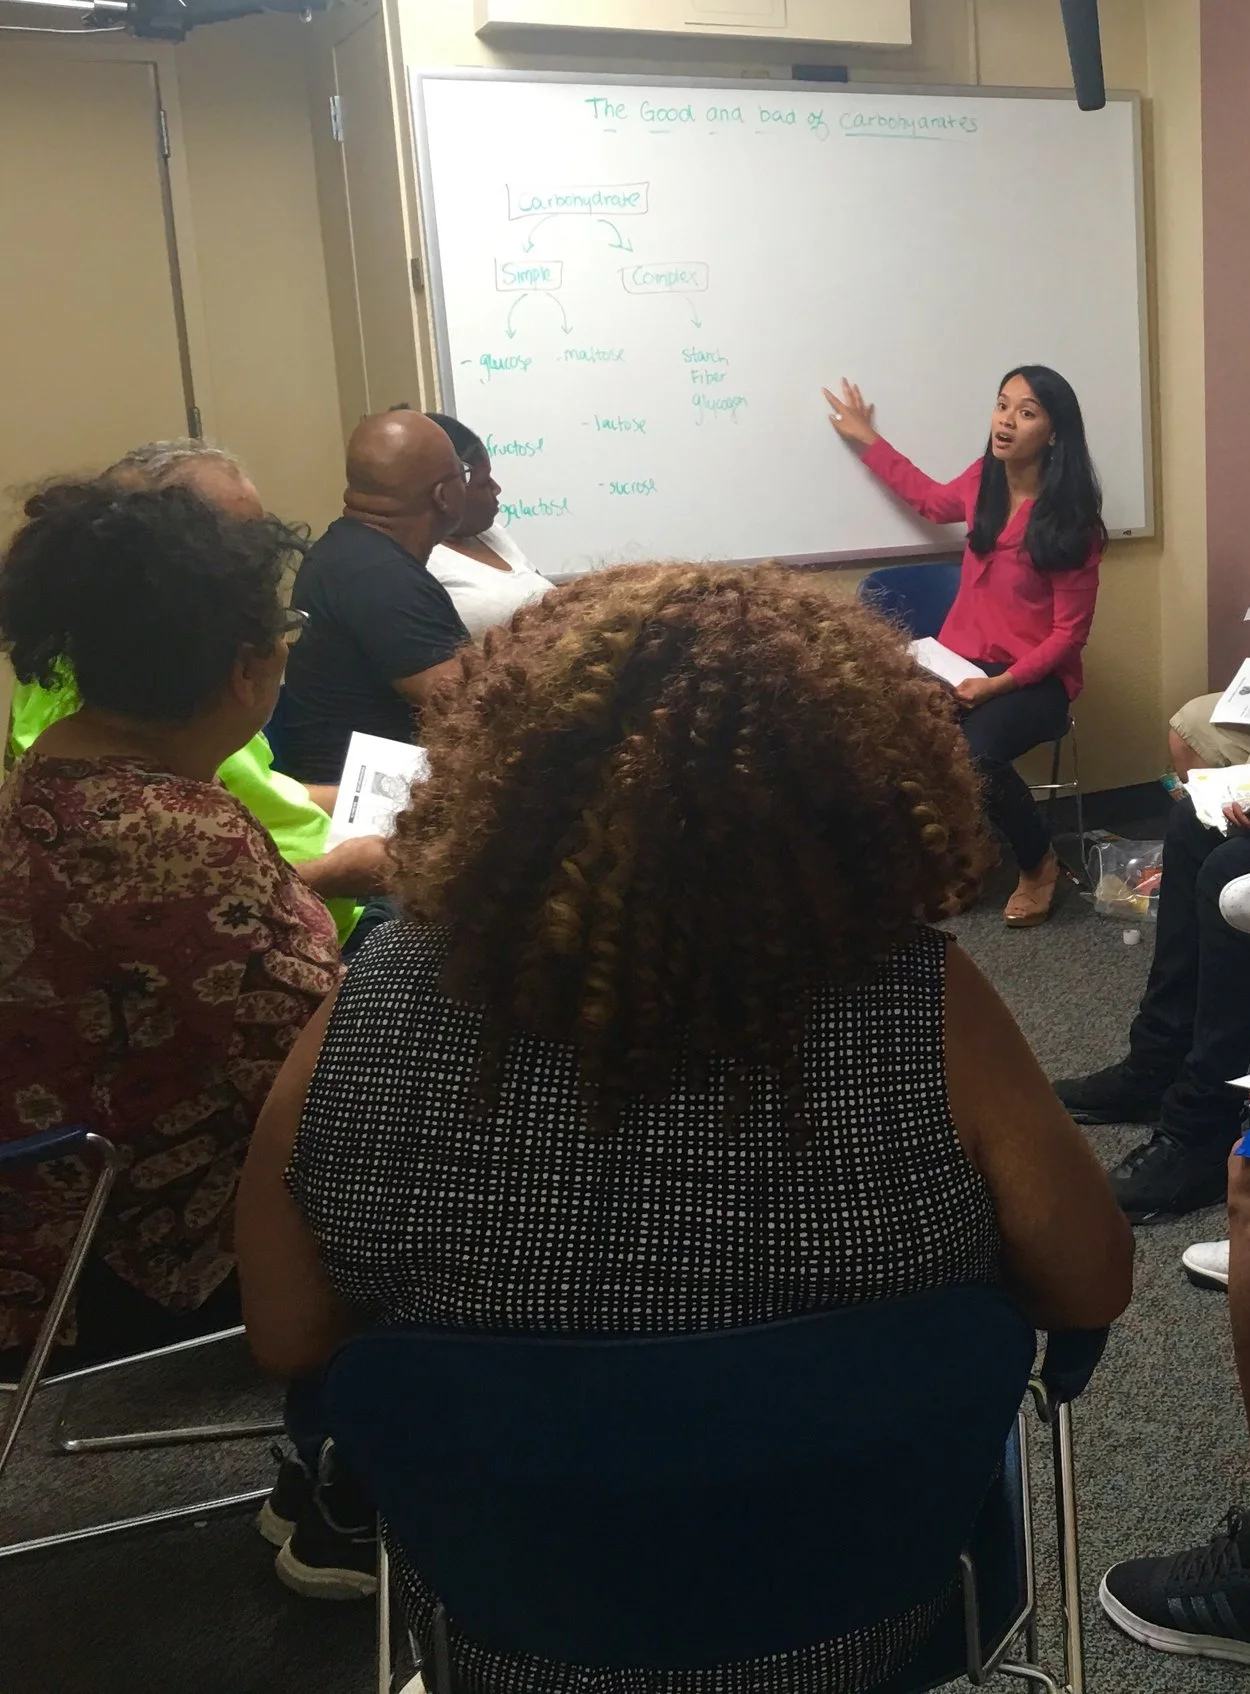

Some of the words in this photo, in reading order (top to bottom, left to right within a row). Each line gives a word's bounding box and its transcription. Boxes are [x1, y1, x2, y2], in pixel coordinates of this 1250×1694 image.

[584, 97, 628, 120] The
[640, 100, 696, 122] Good
[759, 105, 797, 125] bad
[807, 109, 830, 142] of
[502, 263, 553, 289] Simple
[632, 265, 700, 291] Complex
[691, 369, 727, 385] Fiber
[594, 415, 647, 434] lactose
[485, 433, 544, 457] fructose
[609, 478, 658, 495] sucrose
[499, 497, 574, 527] galactose
